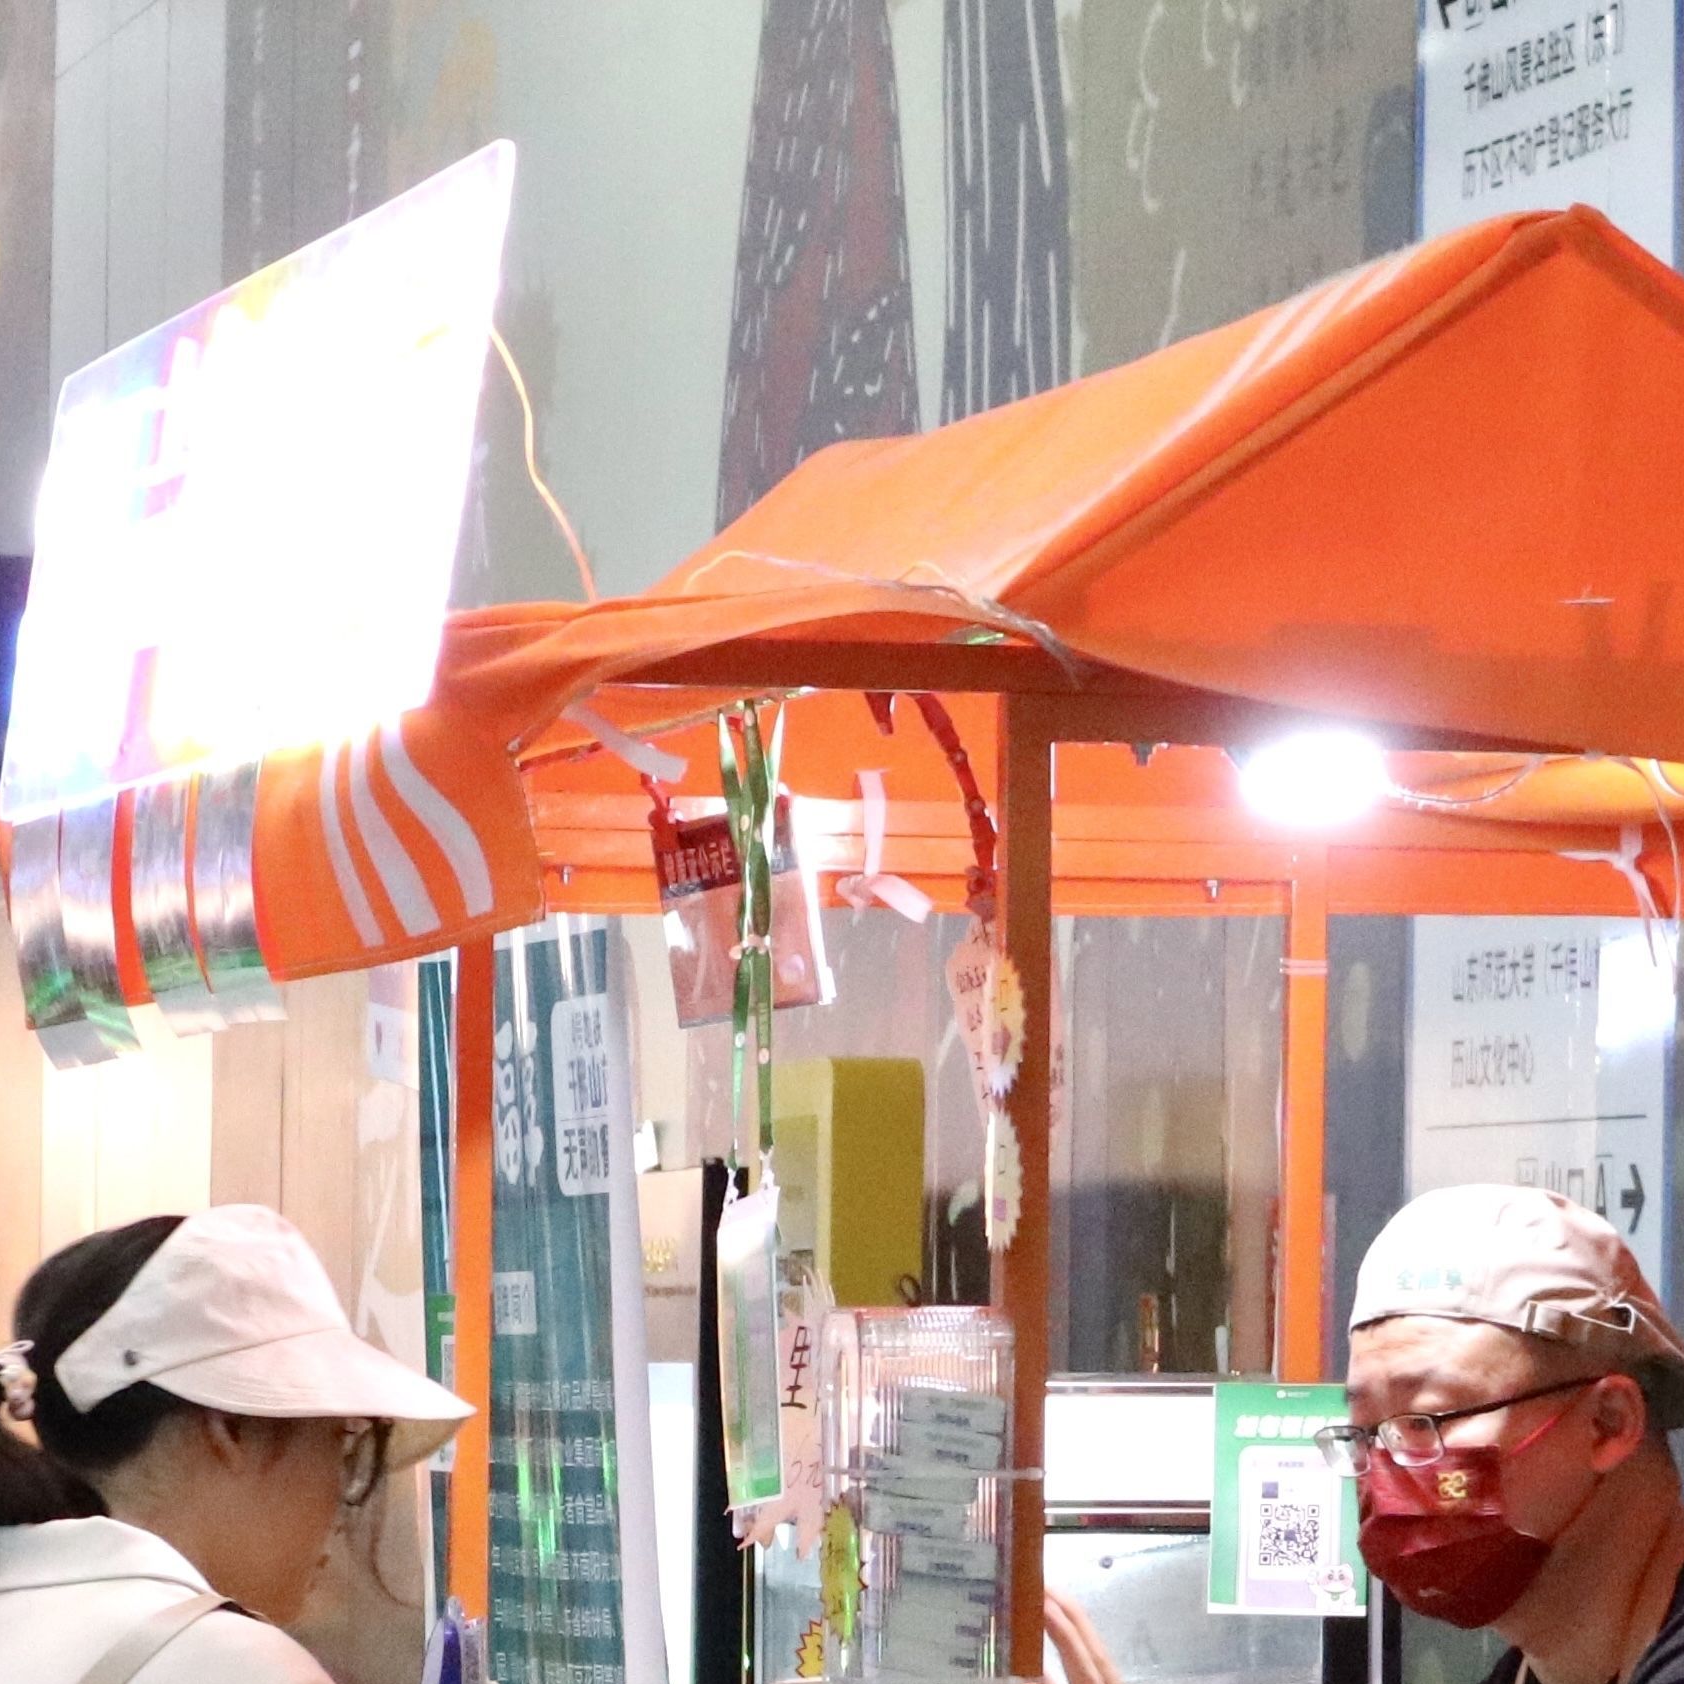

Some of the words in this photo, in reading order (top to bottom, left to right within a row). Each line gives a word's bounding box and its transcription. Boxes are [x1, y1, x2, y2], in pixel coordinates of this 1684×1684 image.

[1451, 1033, 1535, 1090] 历山文化中心
